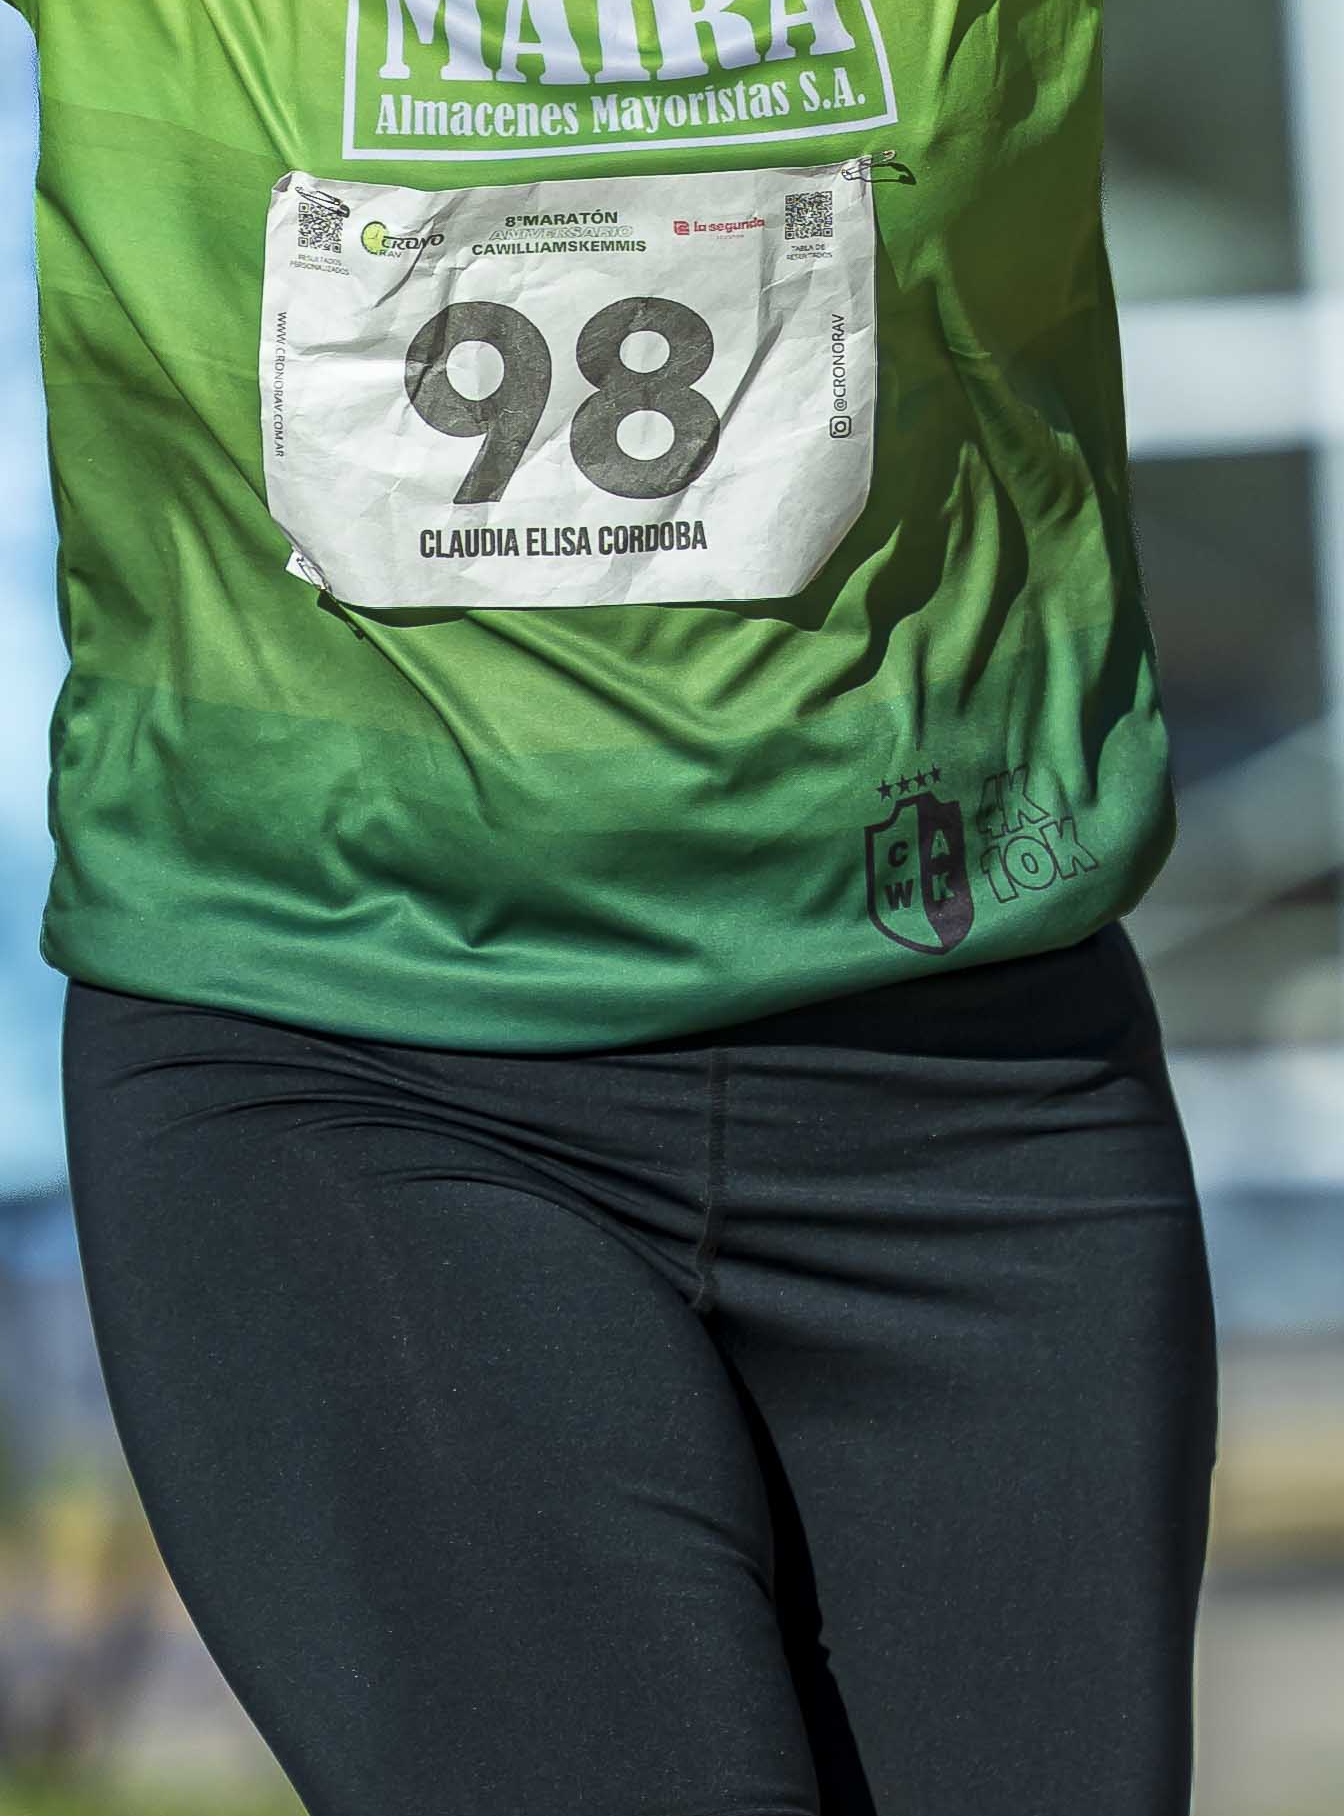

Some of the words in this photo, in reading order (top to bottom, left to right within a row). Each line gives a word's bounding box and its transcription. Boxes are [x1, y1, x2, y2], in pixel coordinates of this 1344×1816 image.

[375, 94, 579, 137] Almacenes
[590, 81, 791, 134] Mayoristas
[799, 67, 867, 113] S.A.
[489, 225, 633, 241] ANIVERSARIO
[708, 217, 766, 234] segunda
[471, 240, 647, 256] CAWILLIAMSKEMMIS
[831, 313, 848, 412] @CRONORAV
[404, 296, 721, 505] 98
[419, 528, 520, 558] CLAUDIA
[526, 526, 592, 557] ELISA
[597, 520, 708, 555] CORDOBA
[888, 841, 909, 868] C
[979, 815, 1100, 904] 10K
[884, 878, 914, 911] W
